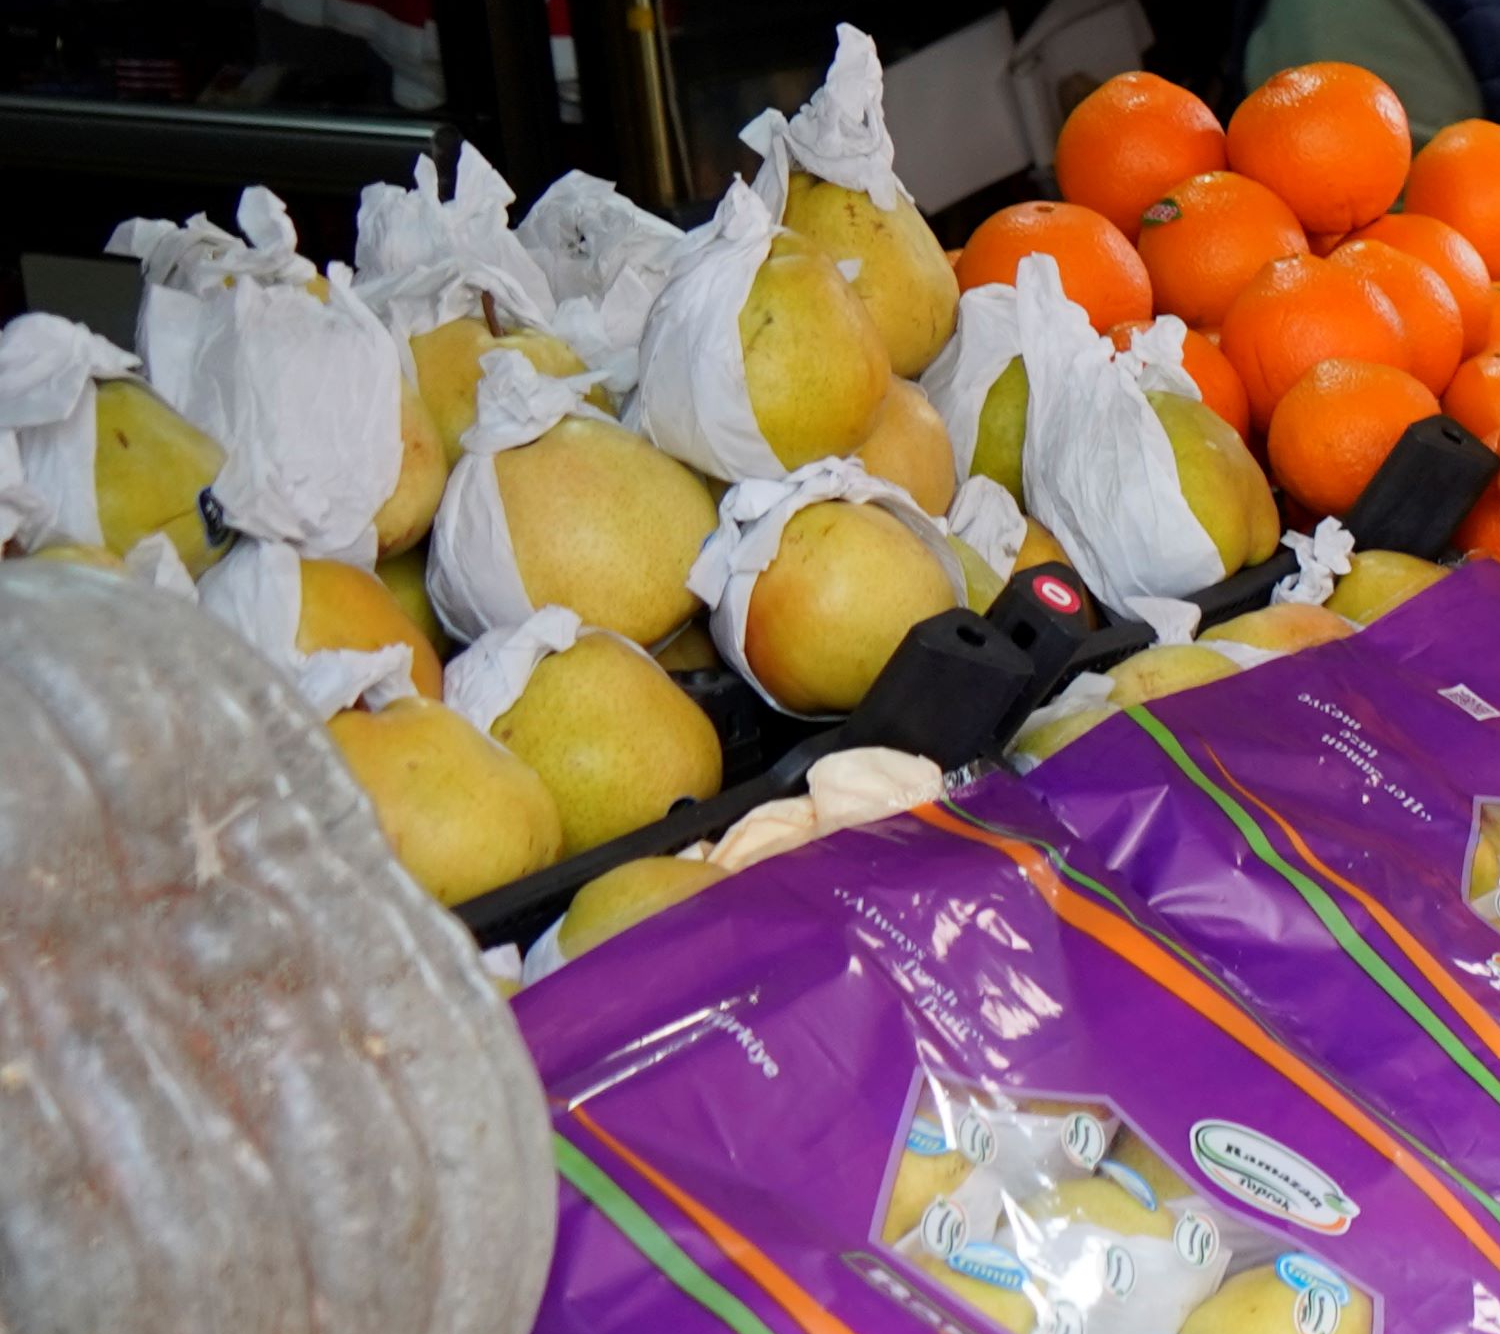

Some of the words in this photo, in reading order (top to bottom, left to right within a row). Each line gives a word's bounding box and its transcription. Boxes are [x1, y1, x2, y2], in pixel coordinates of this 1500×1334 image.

[1298, 692, 1361, 731] meyve
[1339, 729, 1378, 759] taze
[900, 958, 959, 1007] fresh
[1225, 1141, 1323, 1209] Ramazan
